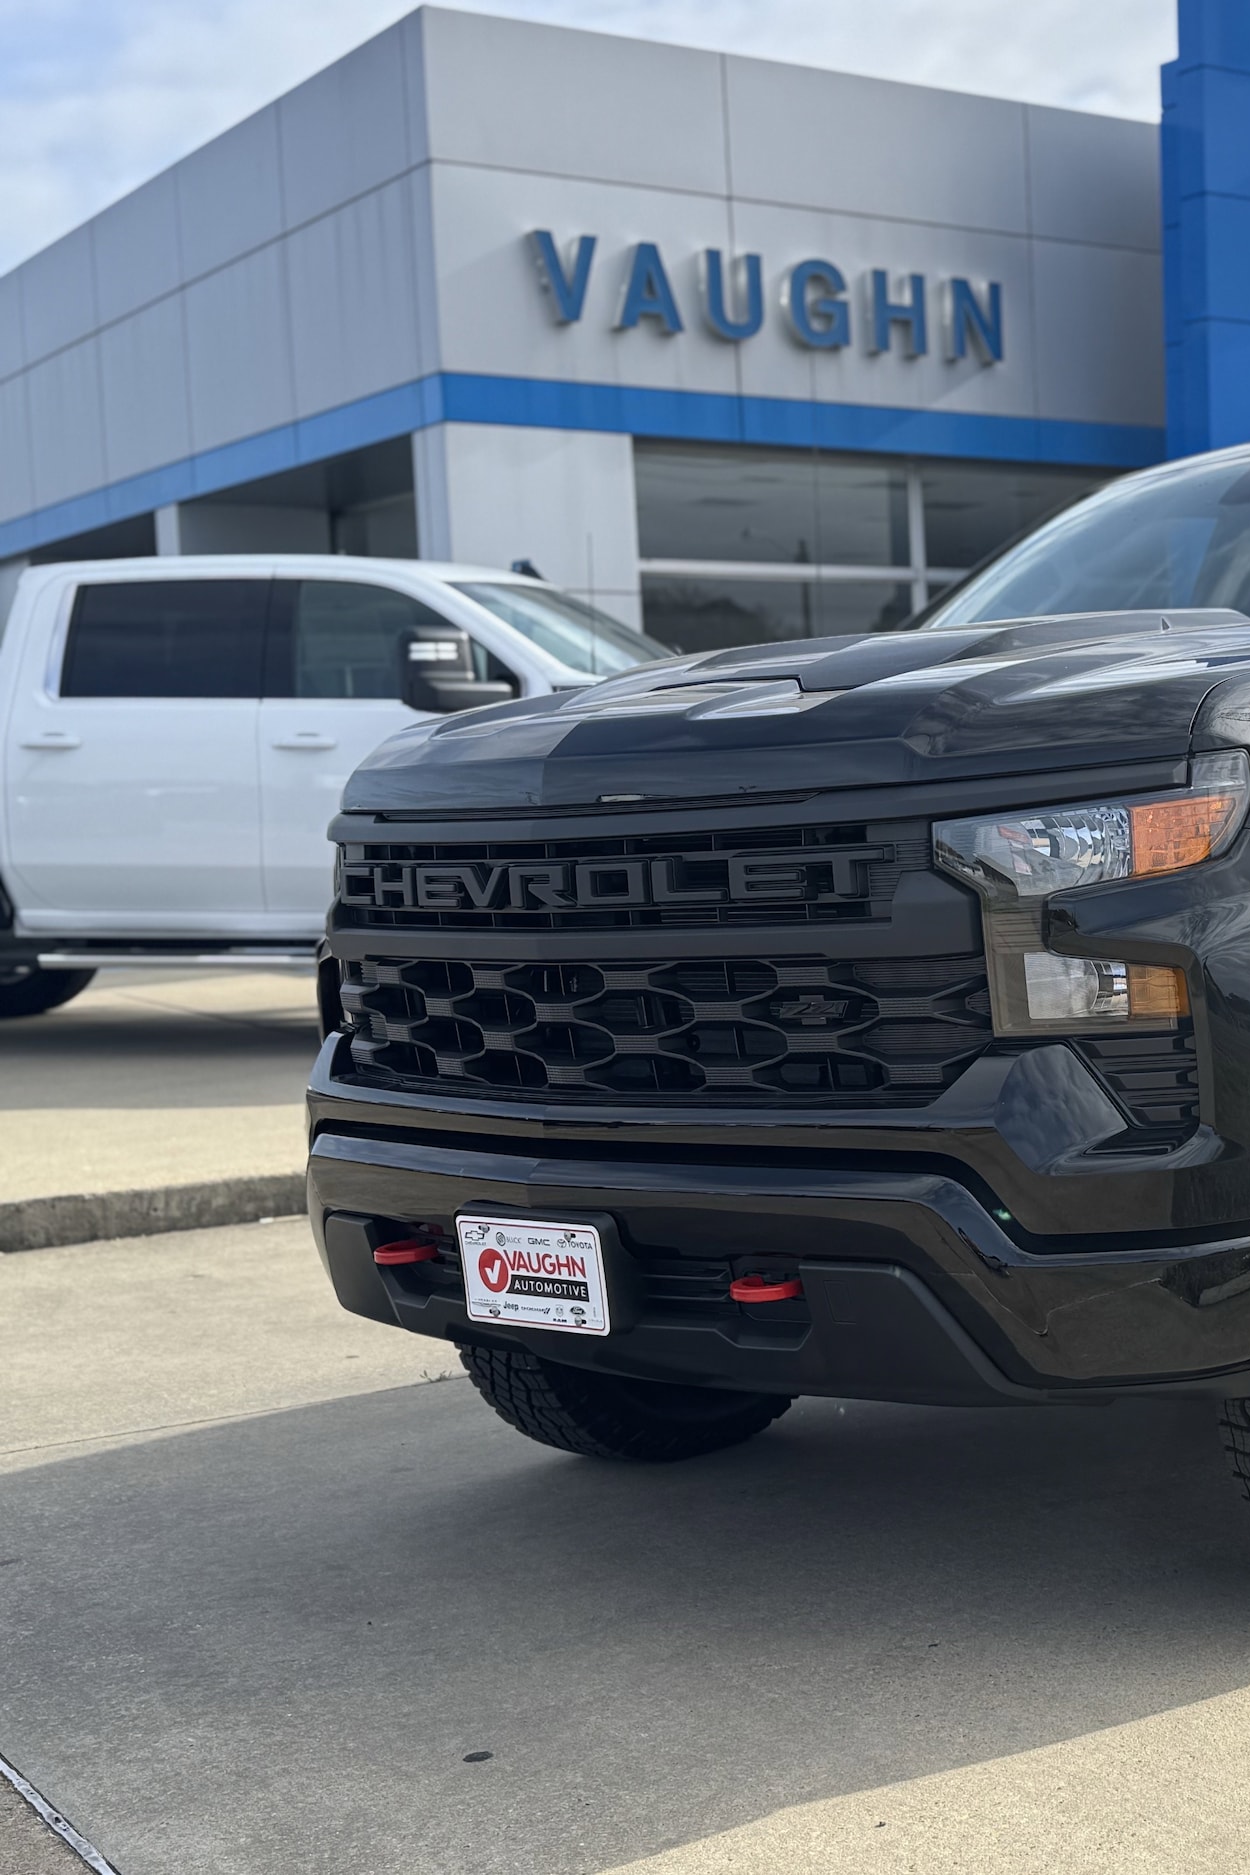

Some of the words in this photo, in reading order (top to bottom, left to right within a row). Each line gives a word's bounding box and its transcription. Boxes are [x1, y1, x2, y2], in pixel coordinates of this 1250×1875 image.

[530, 229, 1004, 365] VAUGHN
[341, 846, 889, 908] CHEVROLET
[527, 1237, 551, 1247] GMC
[567, 1239, 593, 1251] TOYOTA
[503, 1249, 586, 1278] VAUGHN
[513, 1279, 588, 1298] AUTOMOTIVE
[503, 1301, 519, 1313] Jeep
